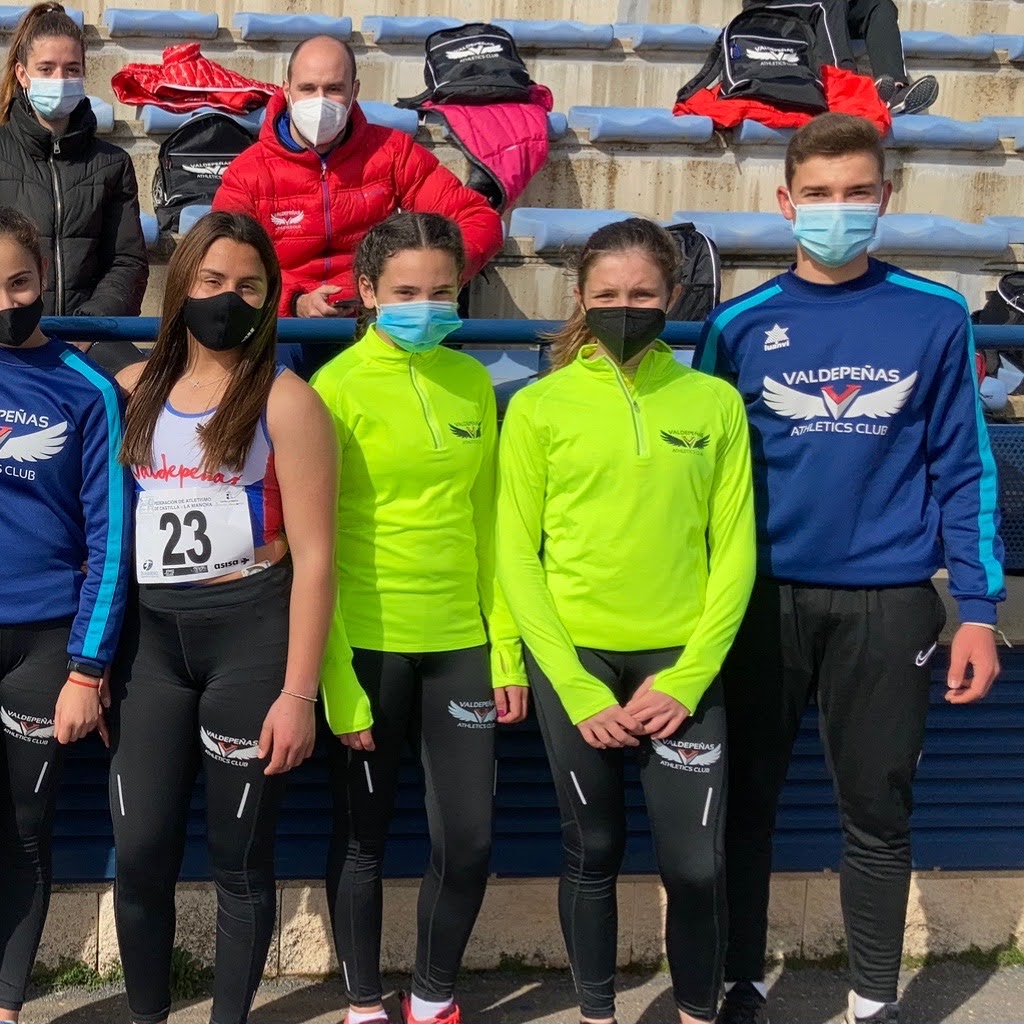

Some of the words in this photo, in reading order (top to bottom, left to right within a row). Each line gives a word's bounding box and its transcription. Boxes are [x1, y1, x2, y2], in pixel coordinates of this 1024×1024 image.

[764, 340, 790, 351] luanvi
[783, 365, 900, 385] VALDEPEÑAS
[791, 422, 853, 436] ATHLETICS
[856, 423, 888, 436] CLUB
[5, 466, 36, 481] CLUB
[160, 510, 212, 566] 23
[214, 560, 238, 570] asisa
[662, 739, 715, 750] VALDEPEÑAS
[231, 760, 249, 768] CLUB
[660, 760, 693, 772] ATHLETICS
